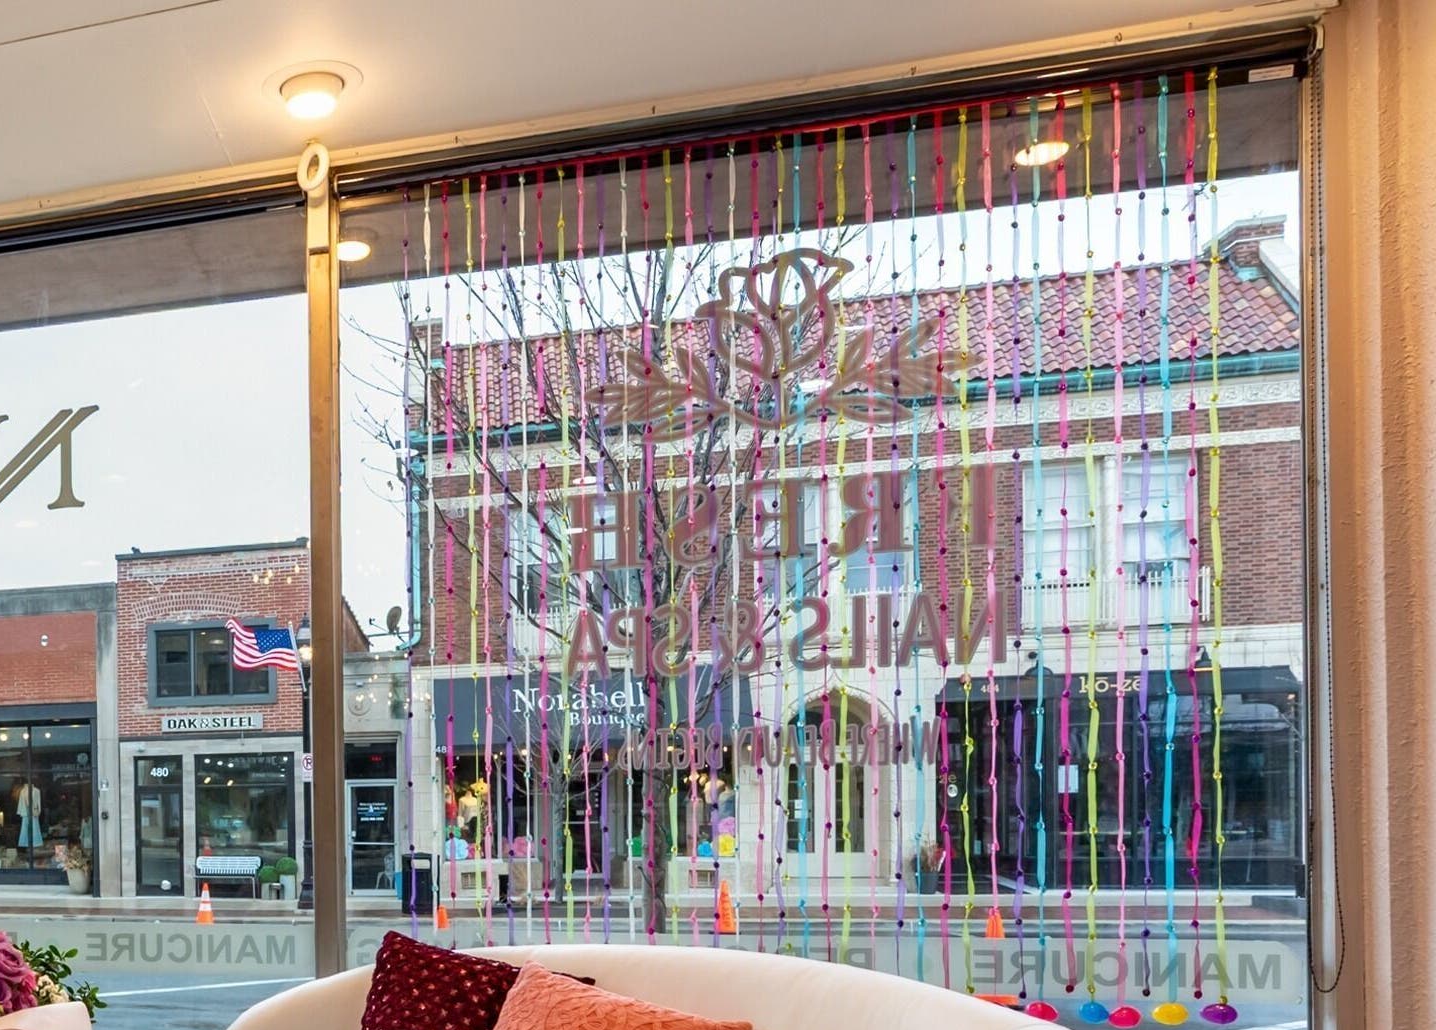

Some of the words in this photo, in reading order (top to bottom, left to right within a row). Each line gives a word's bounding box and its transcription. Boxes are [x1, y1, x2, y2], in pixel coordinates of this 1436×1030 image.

[167, 717, 198, 730] OAK
[212, 716, 256, 728] STEEL
[150, 767, 169, 777] 480
